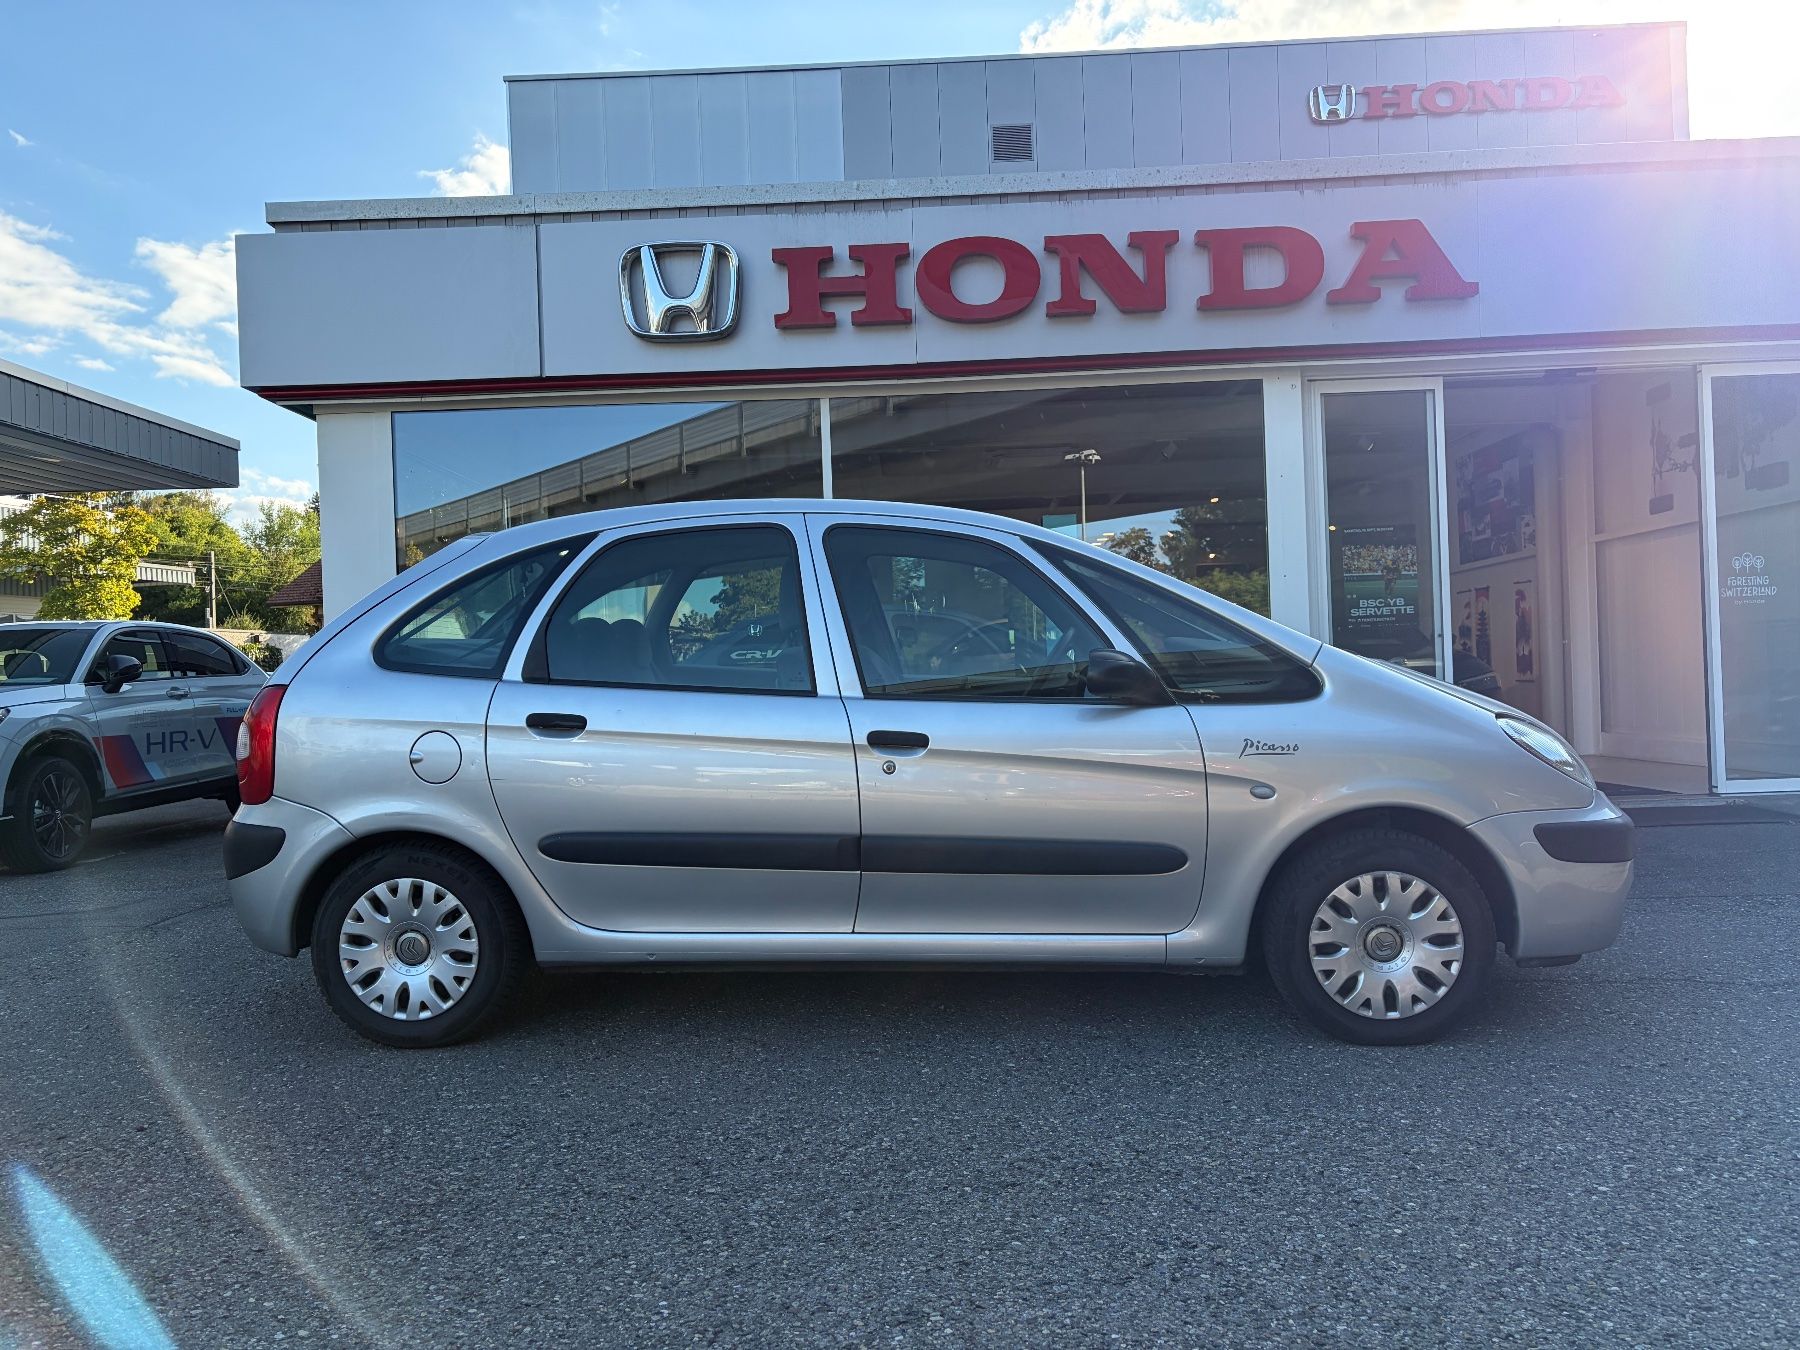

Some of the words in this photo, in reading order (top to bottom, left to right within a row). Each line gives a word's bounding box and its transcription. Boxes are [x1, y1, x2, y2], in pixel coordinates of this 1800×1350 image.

[1363, 75, 1626, 119] HONDA
[771, 218, 1480, 330] HONDA
[1359, 598, 1385, 607] BSC
[1387, 598, 1405, 606] YB
[1721, 587, 1777, 598] SWITZERLAND
[1350, 606, 1415, 617] SERVETTE
[729, 649, 784, 660] CR-V
[146, 728, 217, 755] HR-V
[1239, 738, 1300, 759] Picasso
[407, 855, 469, 885] NEXEN
